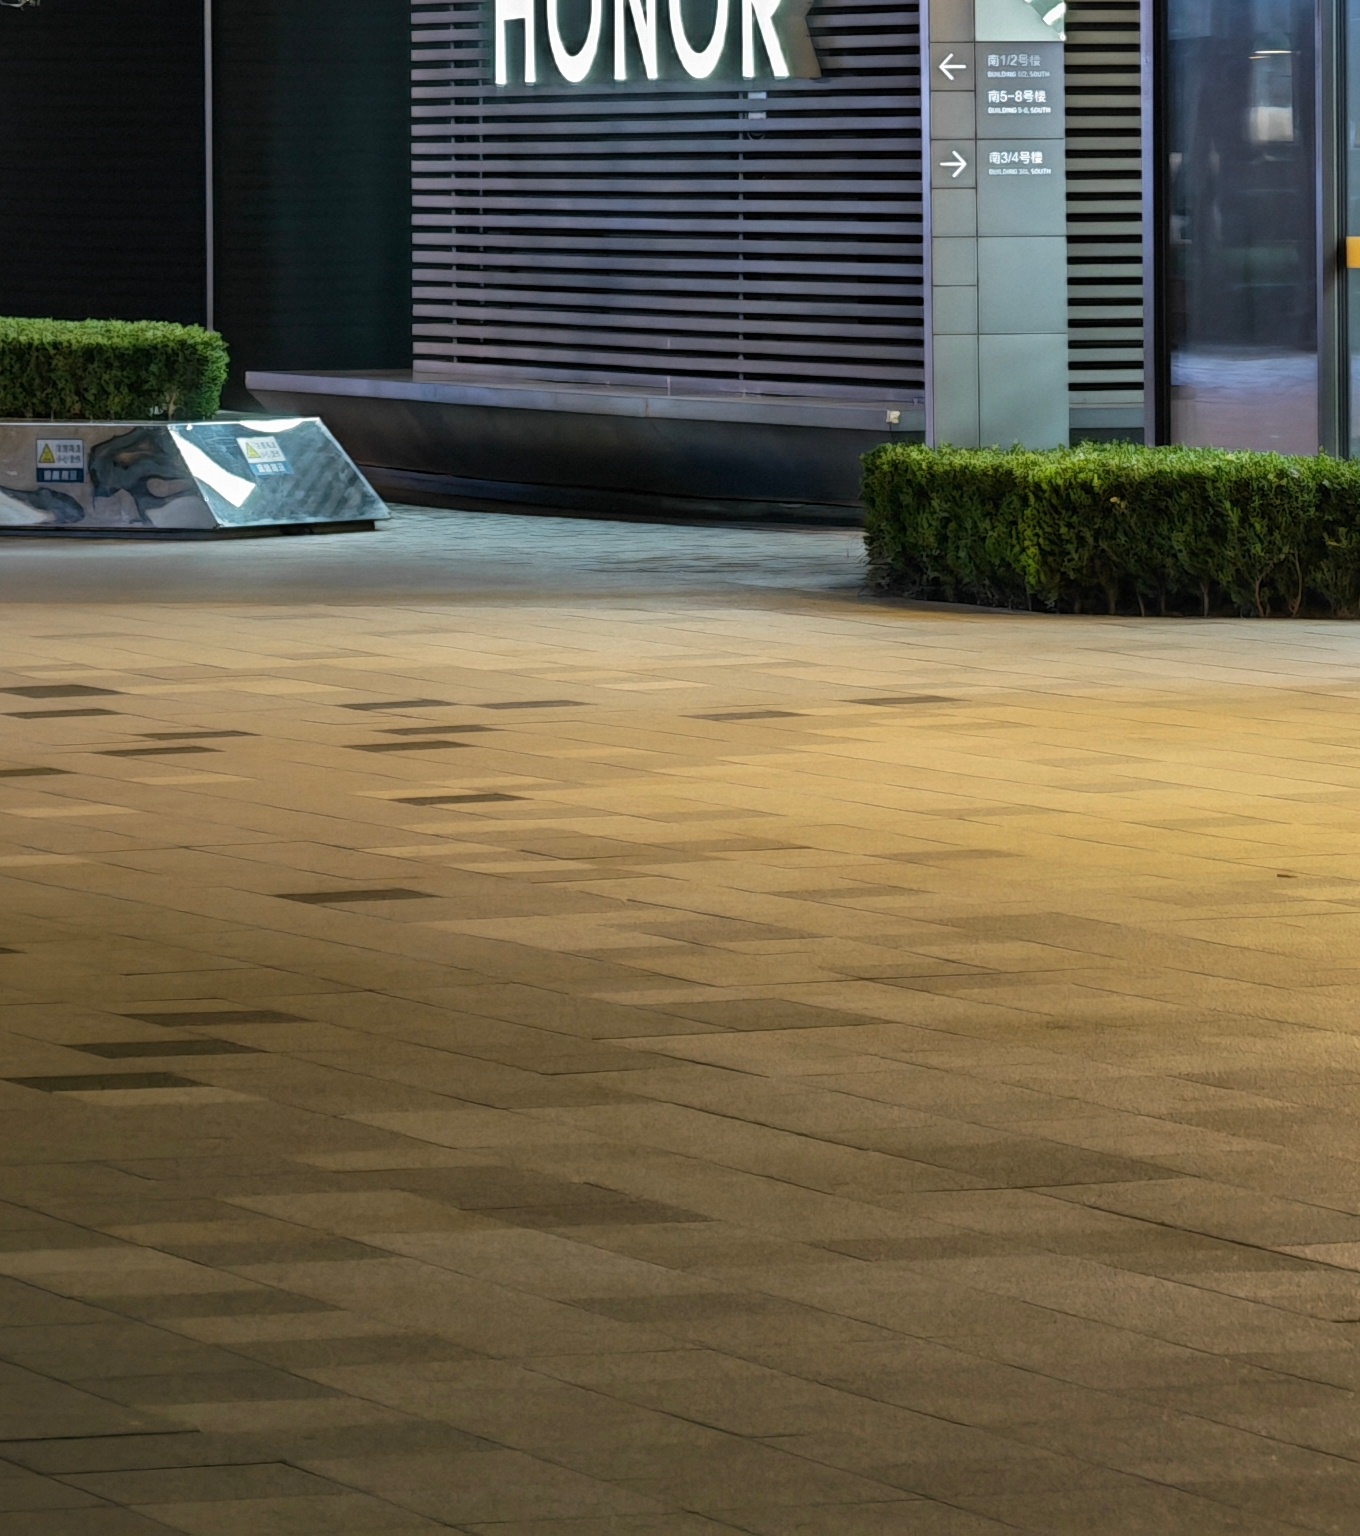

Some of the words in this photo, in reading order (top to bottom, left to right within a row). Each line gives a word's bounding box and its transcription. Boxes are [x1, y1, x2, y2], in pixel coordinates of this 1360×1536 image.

[987, 54, 1041, 67] 南1/2号楼
[987, 90, 1047, 103] 南5-8号楼
[989, 151, 1043, 164] 南3/4号楼
